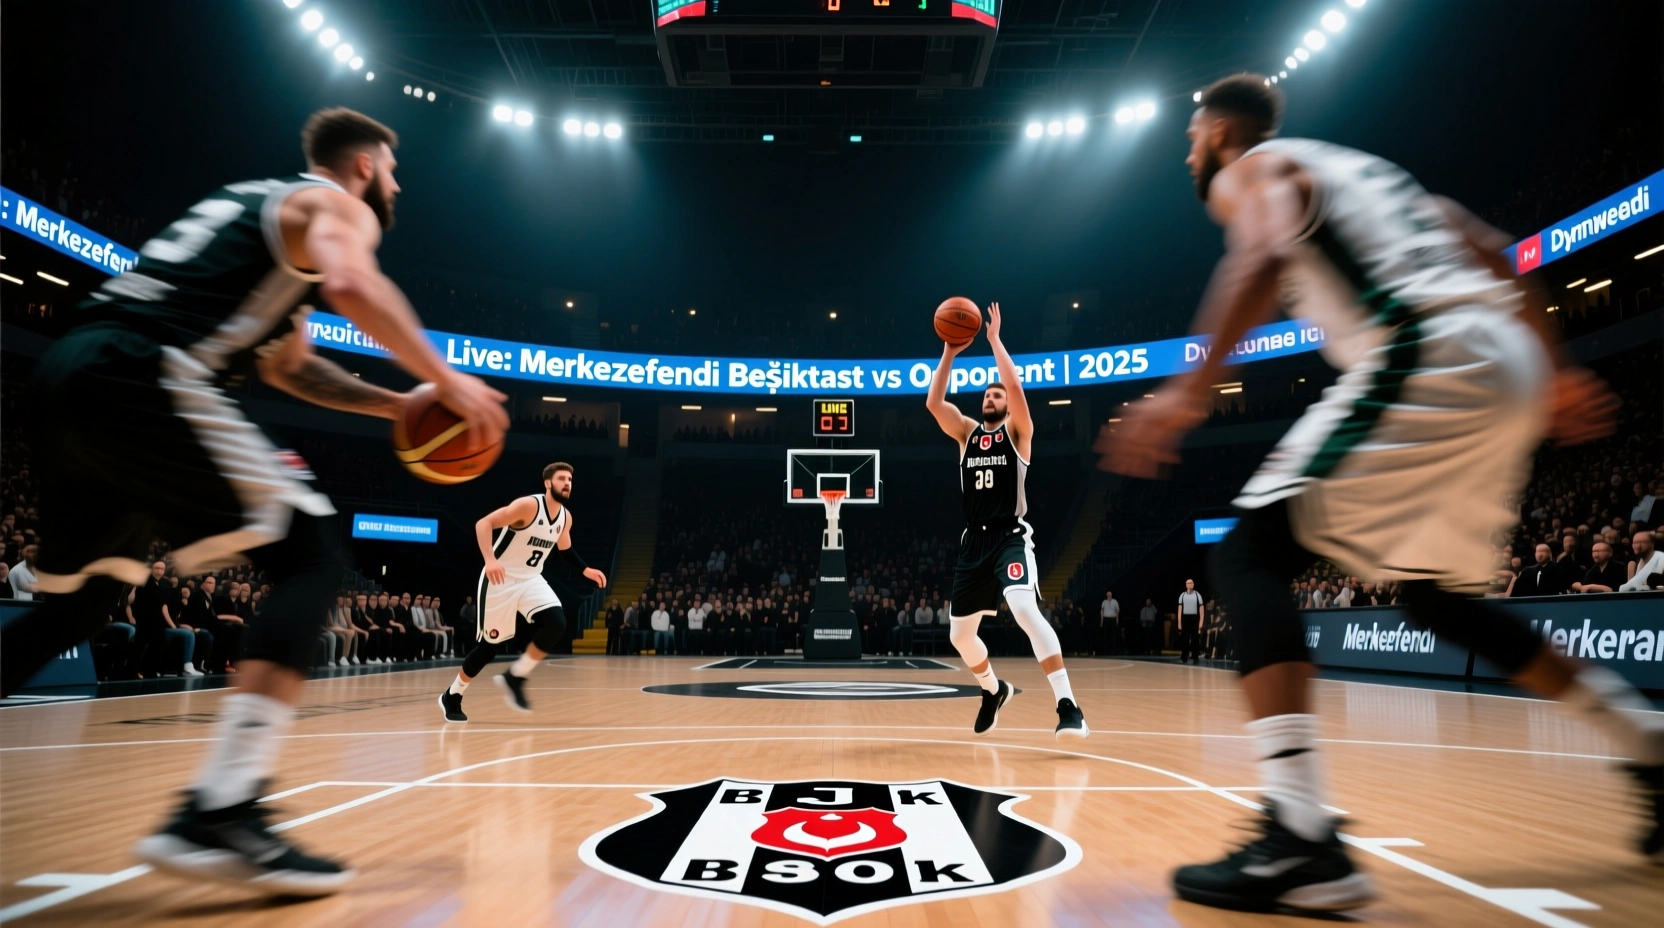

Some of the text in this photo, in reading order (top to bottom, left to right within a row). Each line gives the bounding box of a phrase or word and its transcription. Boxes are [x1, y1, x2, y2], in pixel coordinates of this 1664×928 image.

[447, 338, 512, 371] Live:
[519, 348, 719, 387] Merkezefendi
[871, 370, 902, 389] vs
[1078, 348, 1149, 380] 2025
[526, 549, 544, 568] 8
